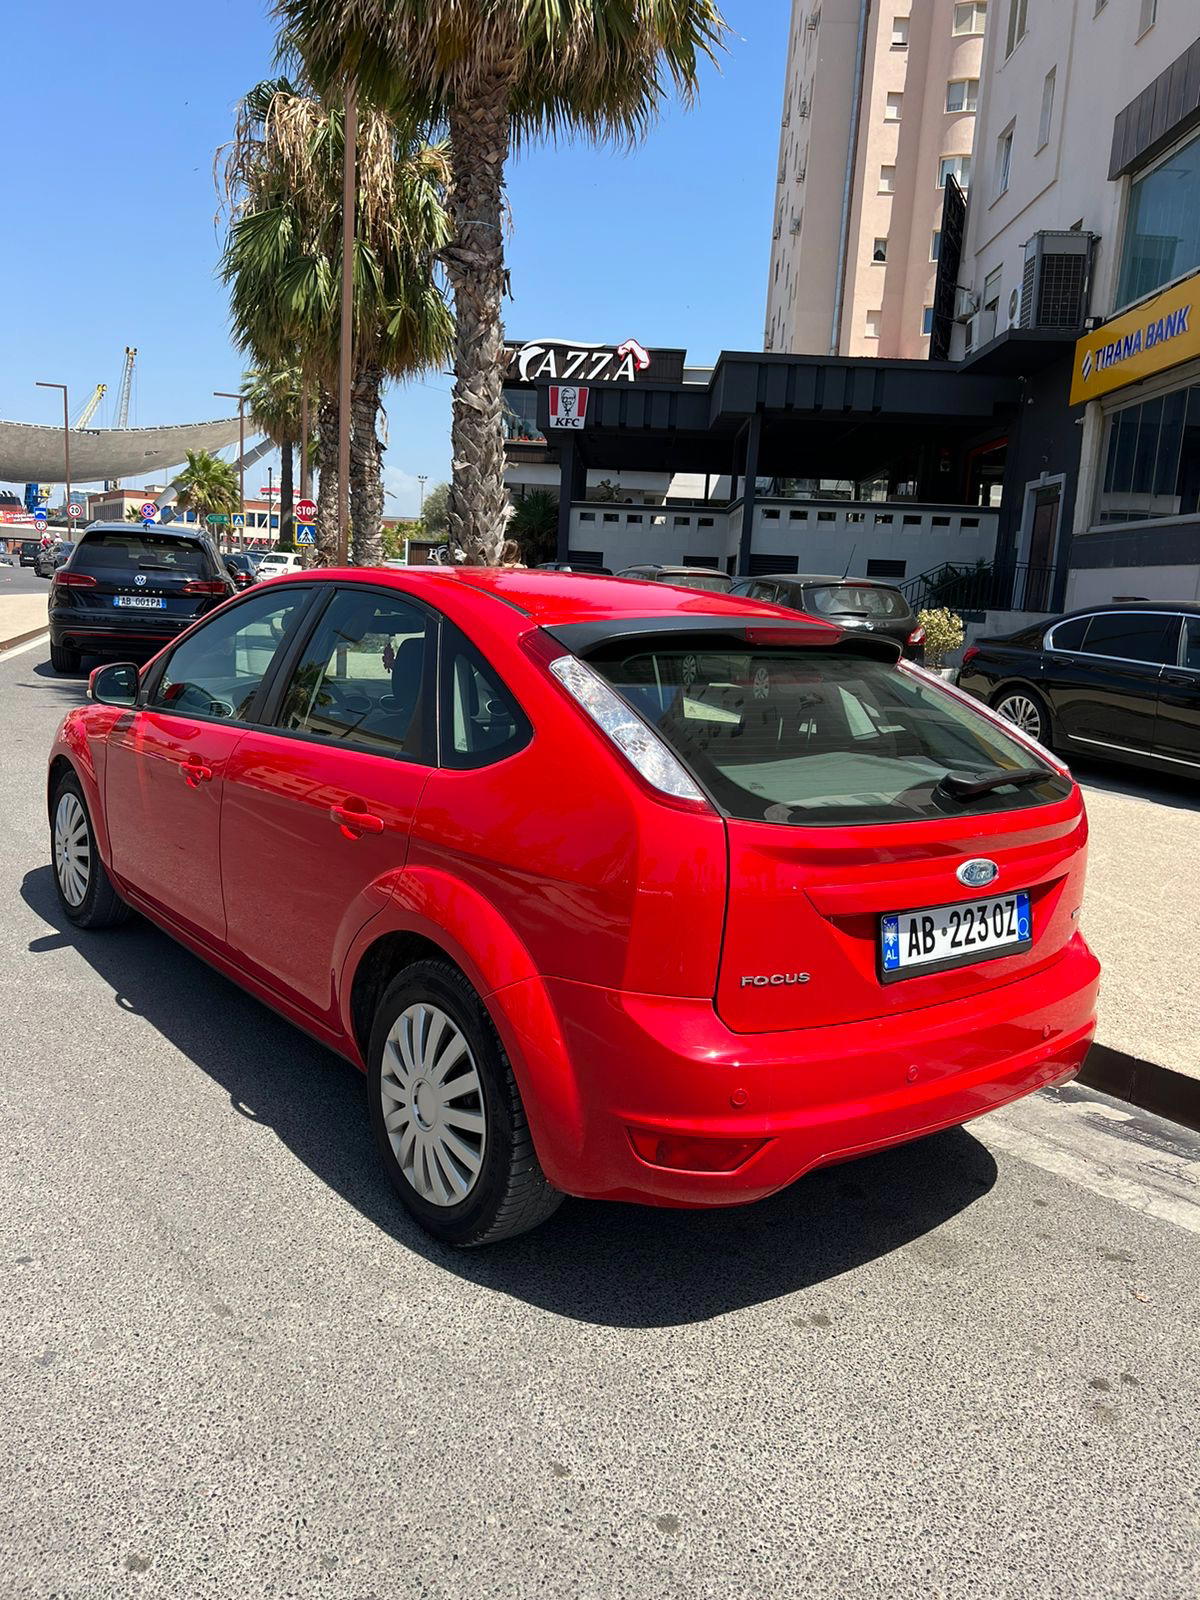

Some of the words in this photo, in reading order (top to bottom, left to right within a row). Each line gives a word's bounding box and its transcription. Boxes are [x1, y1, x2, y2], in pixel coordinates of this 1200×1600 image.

[1095, 328, 1143, 372] TIRANA
[1145, 303, 1192, 350] BANK
[555, 417, 580, 428] KFC
[296, 505, 317, 515] STOP
[121, 596, 132, 606] AB
[907, 916, 936, 958] AB
[885, 949, 898, 961] AL
[741, 972, 811, 987] FOCUS
